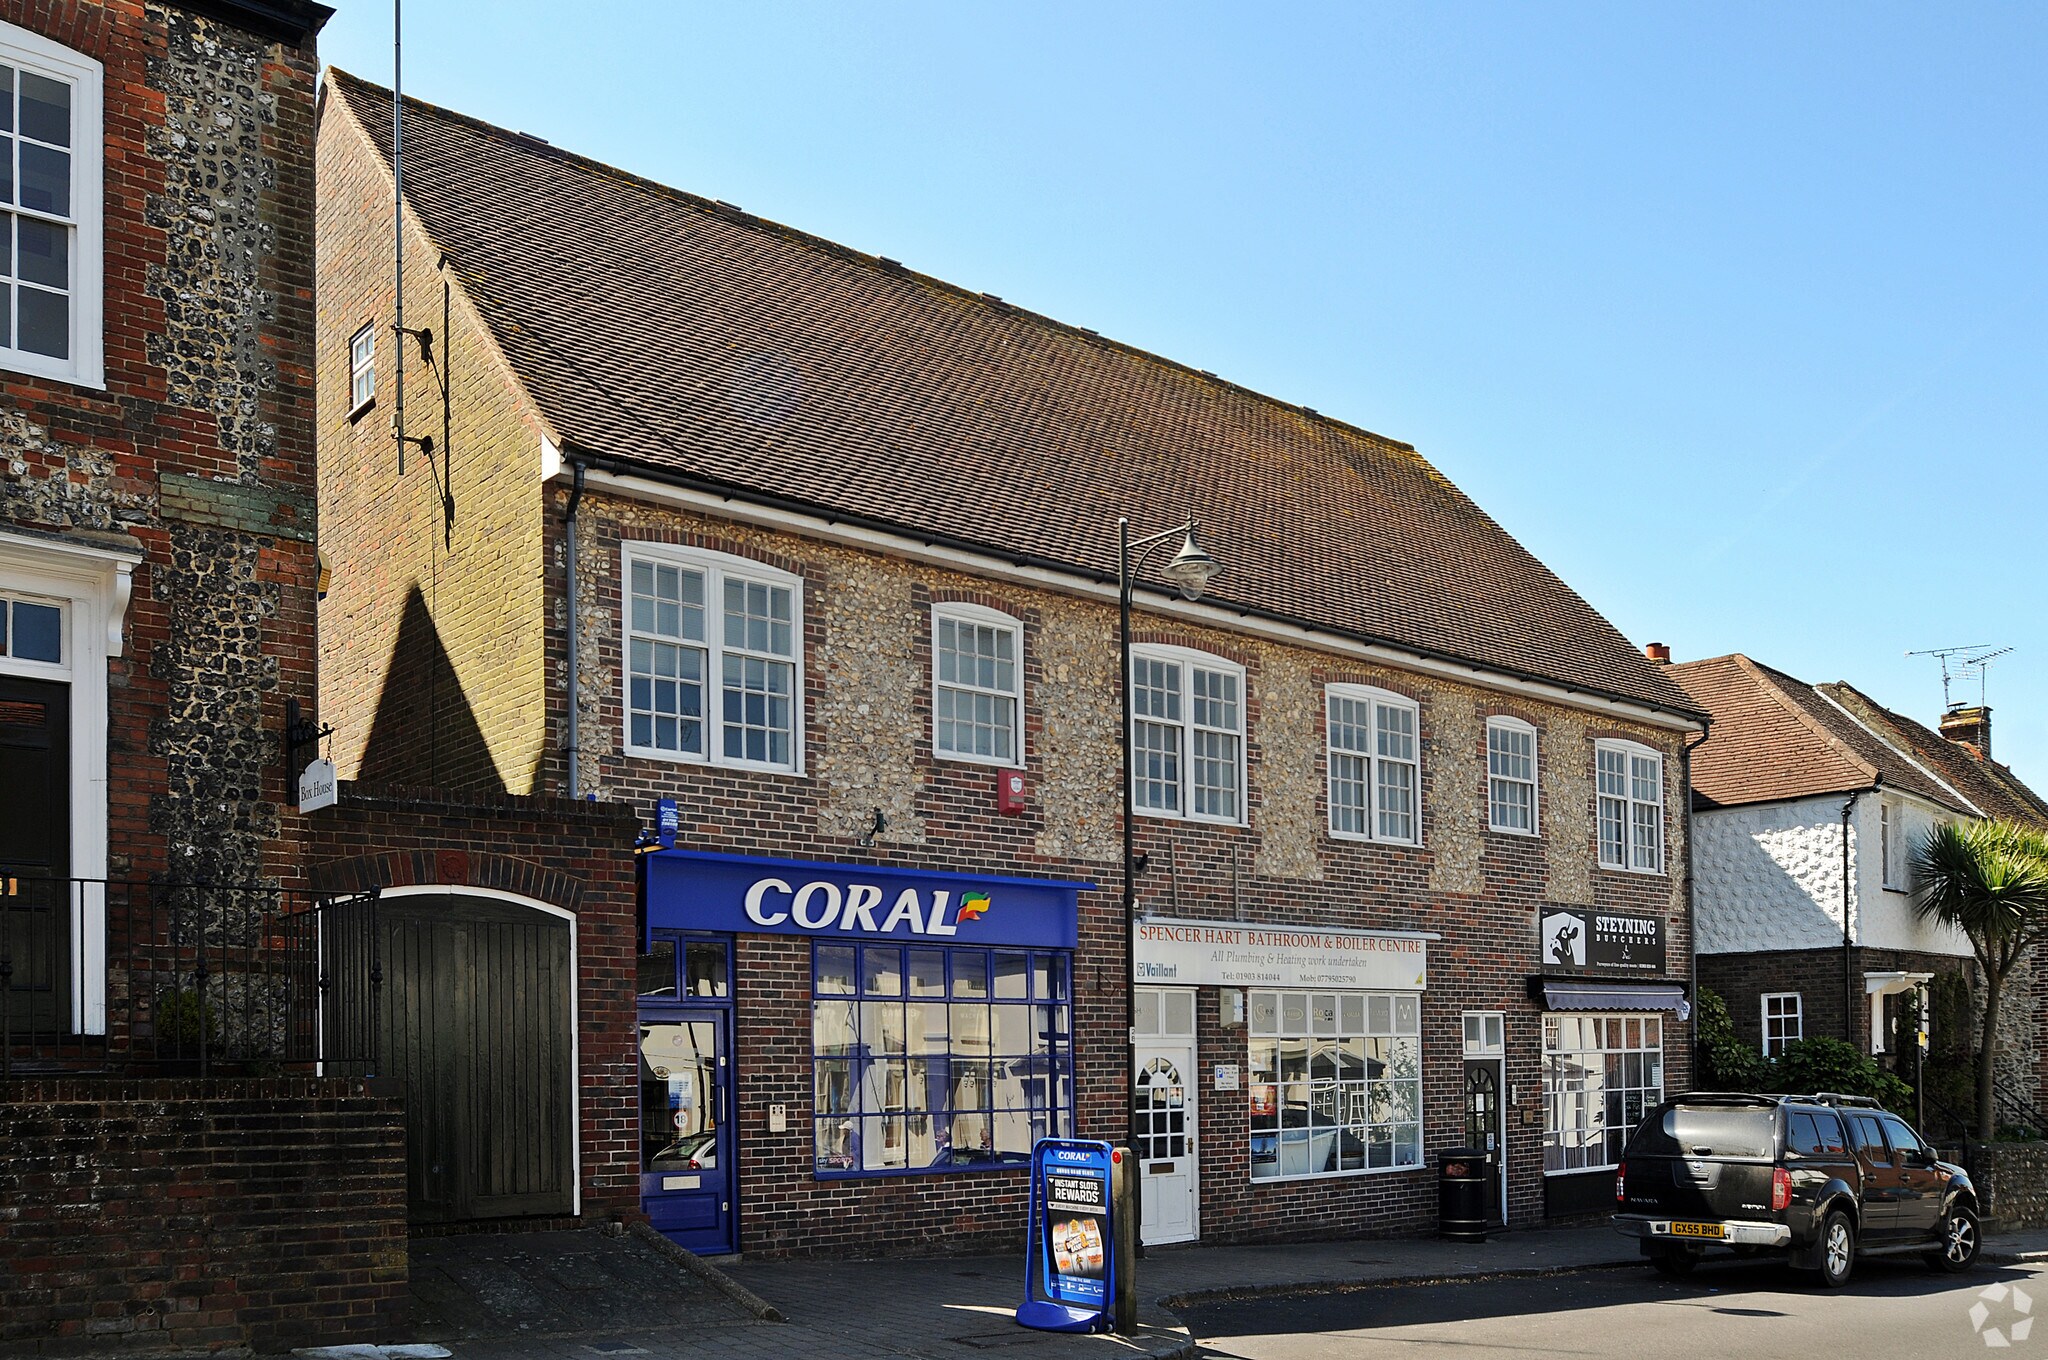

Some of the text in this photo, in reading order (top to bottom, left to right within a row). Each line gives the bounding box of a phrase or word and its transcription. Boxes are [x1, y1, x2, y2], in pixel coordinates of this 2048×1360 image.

[301, 781, 333, 801] Box House
[744, 877, 957, 936] CORAL
[1595, 916, 1656, 935] STEYNING
[1140, 925, 1421, 953] SPENCER HART BATHROOM & BOILER CENTRE
[1596, 934, 1656, 945] BUTCHERS
[1211, 950, 1367, 968] All Plumbing & Heating work undertaken
[1146, 963, 1177, 978] Vaillant
[1222, 972, 1235, 980] Tel:
[1235, 972, 1256, 980] 01903
[1299, 974, 1316, 982] Mob:
[1313, 1007, 1333, 1017] Roca
[675, 1114, 686, 1124] 18
[1058, 1151, 1087, 1161] CORAL
[1055, 1179, 1099, 1191] INSTANT SLOTS
[1675, 1223, 1720, 1236] GX55 BHD
